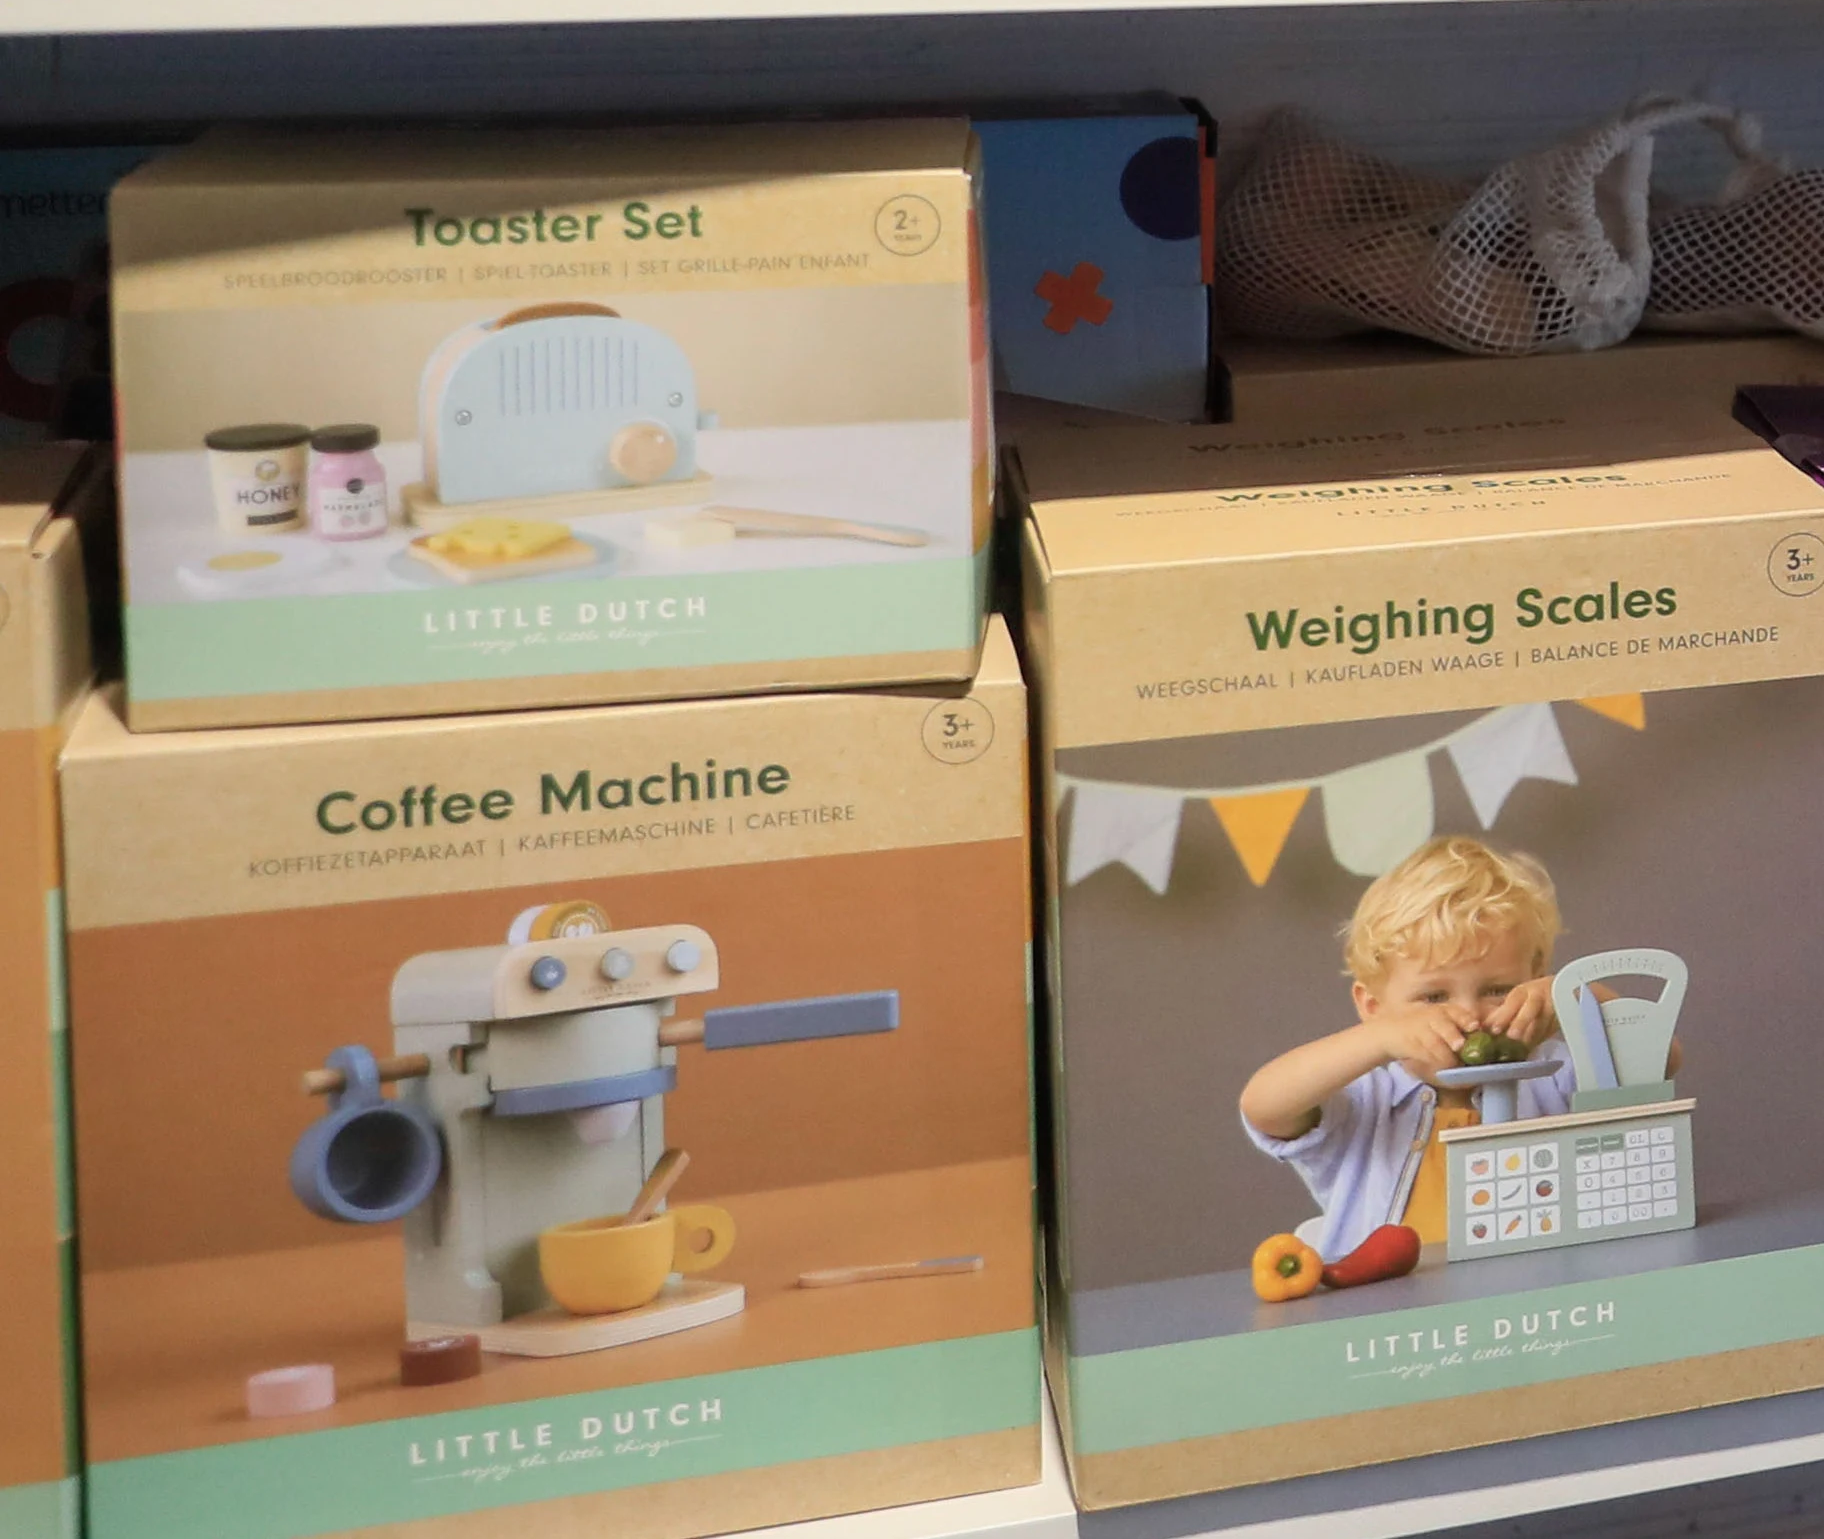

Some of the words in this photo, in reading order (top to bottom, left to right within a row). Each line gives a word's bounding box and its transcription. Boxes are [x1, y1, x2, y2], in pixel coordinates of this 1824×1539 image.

[404, 206, 603, 247] Toaster
[623, 200, 703, 241] Set
[893, 209, 922, 232] 2+
[1215, 480, 1453, 503] Weighing
[1785, 547, 1816, 571] 3+
[423, 603, 554, 634] LITTLE
[577, 596, 706, 625] DUTCH
[1245, 597, 1495, 655] Weighing
[1515, 581, 1678, 628] Scales
[1136, 673, 1280, 700] WEEGSCHAAL
[1305, 656, 1424, 685] KAUFLADEN
[1431, 651, 1505, 673] WAAGE
[1530, 640, 1620, 665] BALANCE
[1626, 637, 1651, 656] DE
[1658, 625, 1779, 653] MARCHANDE
[941, 712, 975, 739] 3+
[316, 783, 516, 835] Coffee
[539, 758, 792, 816] Machine
[248, 838, 489, 879] KOFFIEZETAPPARAAT
[517, 816, 717, 852] KAFFEEMASCHINE
[744, 803, 857, 830] CAFETIÈRE
[1345, 1324, 1469, 1363] LITTLE
[1493, 1300, 1615, 1340] DUTCH
[409, 1422, 554, 1466] LITTLE
[581, 1397, 723, 1440] DUTCH
